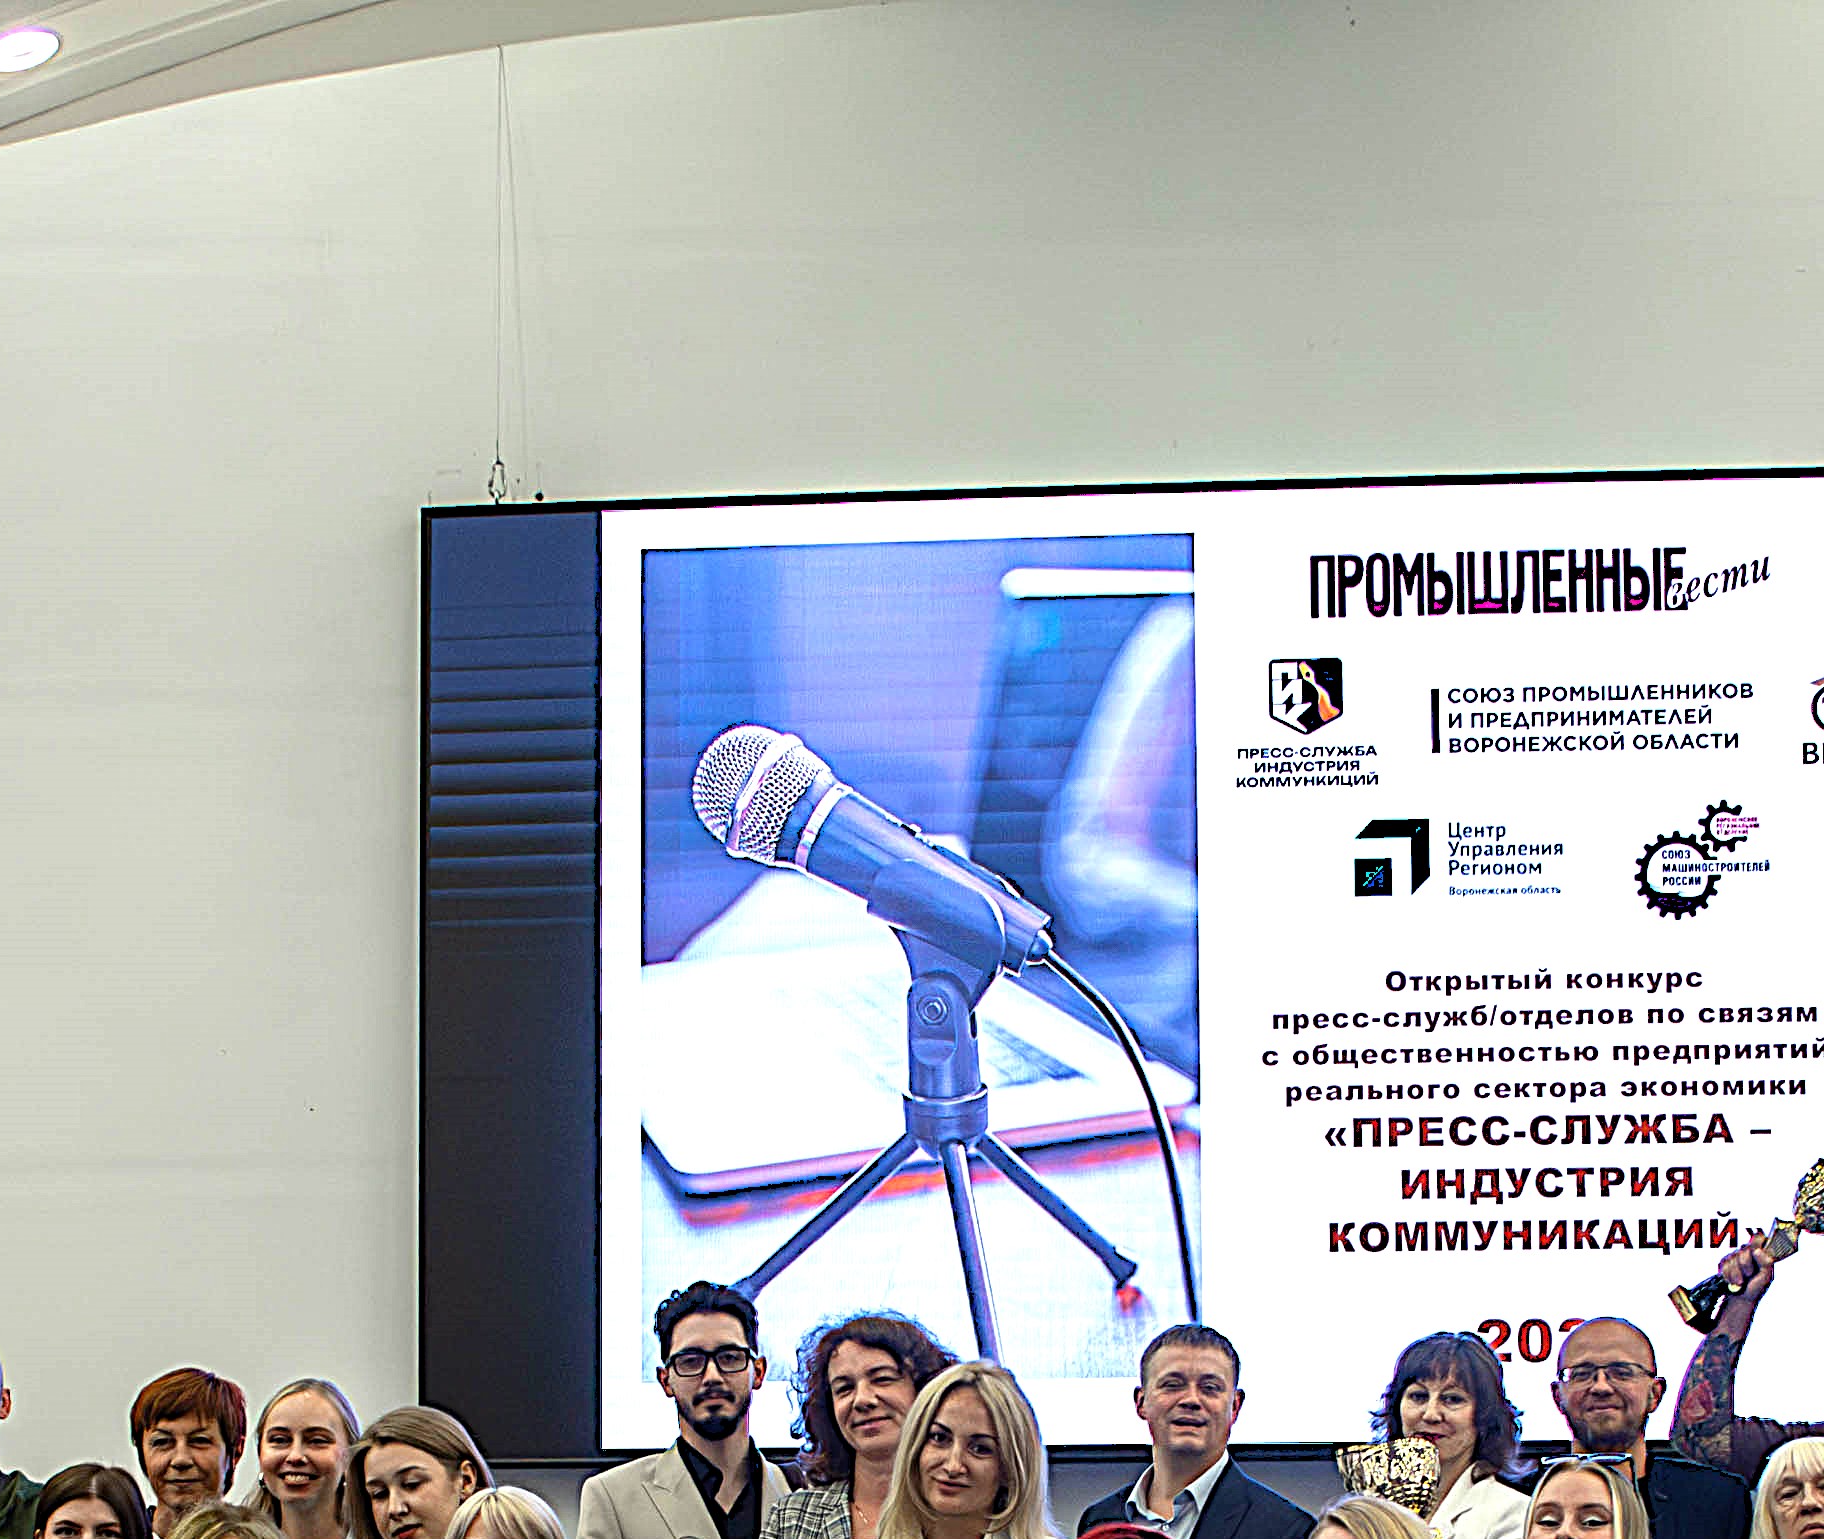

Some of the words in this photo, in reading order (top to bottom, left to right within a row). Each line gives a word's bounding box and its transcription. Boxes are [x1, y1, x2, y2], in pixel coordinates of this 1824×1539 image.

[1310, 547, 1688, 618] ПРОМЫШЛЕННЫЕ
[1665, 556, 1772, 609] вести
[1448, 688, 1514, 703] СОЮЗ
[1523, 683, 1753, 702] ПРОМЫШЛЕННИКОВ
[1449, 713, 1462, 728] И
[1471, 705, 1711, 732] ПРЕДПРИНИМАТЕЛЕЙ
[1449, 729, 1624, 753] ВОРОНЕЖСКОЙ
[1633, 733, 1738, 750] ОБЛАСТИ
[1238, 746, 1377, 761] ПРЕСС-СЛУЖБА
[1237, 769, 1378, 788] КОММУНКИЦИЙ
[1255, 760, 1359, 776] ИНДУСТРИЯ
[1448, 822, 1505, 843] Центр
[1448, 840, 1563, 862] Управления
[1660, 848, 1690, 859] СОЮЗ
[1449, 859, 1541, 875] Регионом
[1663, 860, 1770, 872] МАШИНОСТРОИТЕЛЕЙ
[1449, 887, 1517, 897] Воронежская
[1521, 886, 1561, 895] область
[1663, 876, 1701, 886] РОССИИ
[1386, 968, 1551, 996] Открытый
[1567, 972, 1702, 993] конкурс
[1273, 1005, 1633, 1034] пресс-служб/отделов
[1648, 1008, 1684, 1023] по
[1699, 1007, 1817, 1023] связям
[1262, 1051, 1278, 1066] с
[1293, 1044, 1598, 1068] общественностью
[1286, 1084, 1459, 1107] реального
[1474, 1082, 1606, 1103] сектора
[1621, 1080, 1805, 1097] экономики
[1325, 1113, 1733, 1147] «ПРЕСС-СЛУЖБА
[1402, 1167, 1693, 1205] ИНДУСТРИЯ
